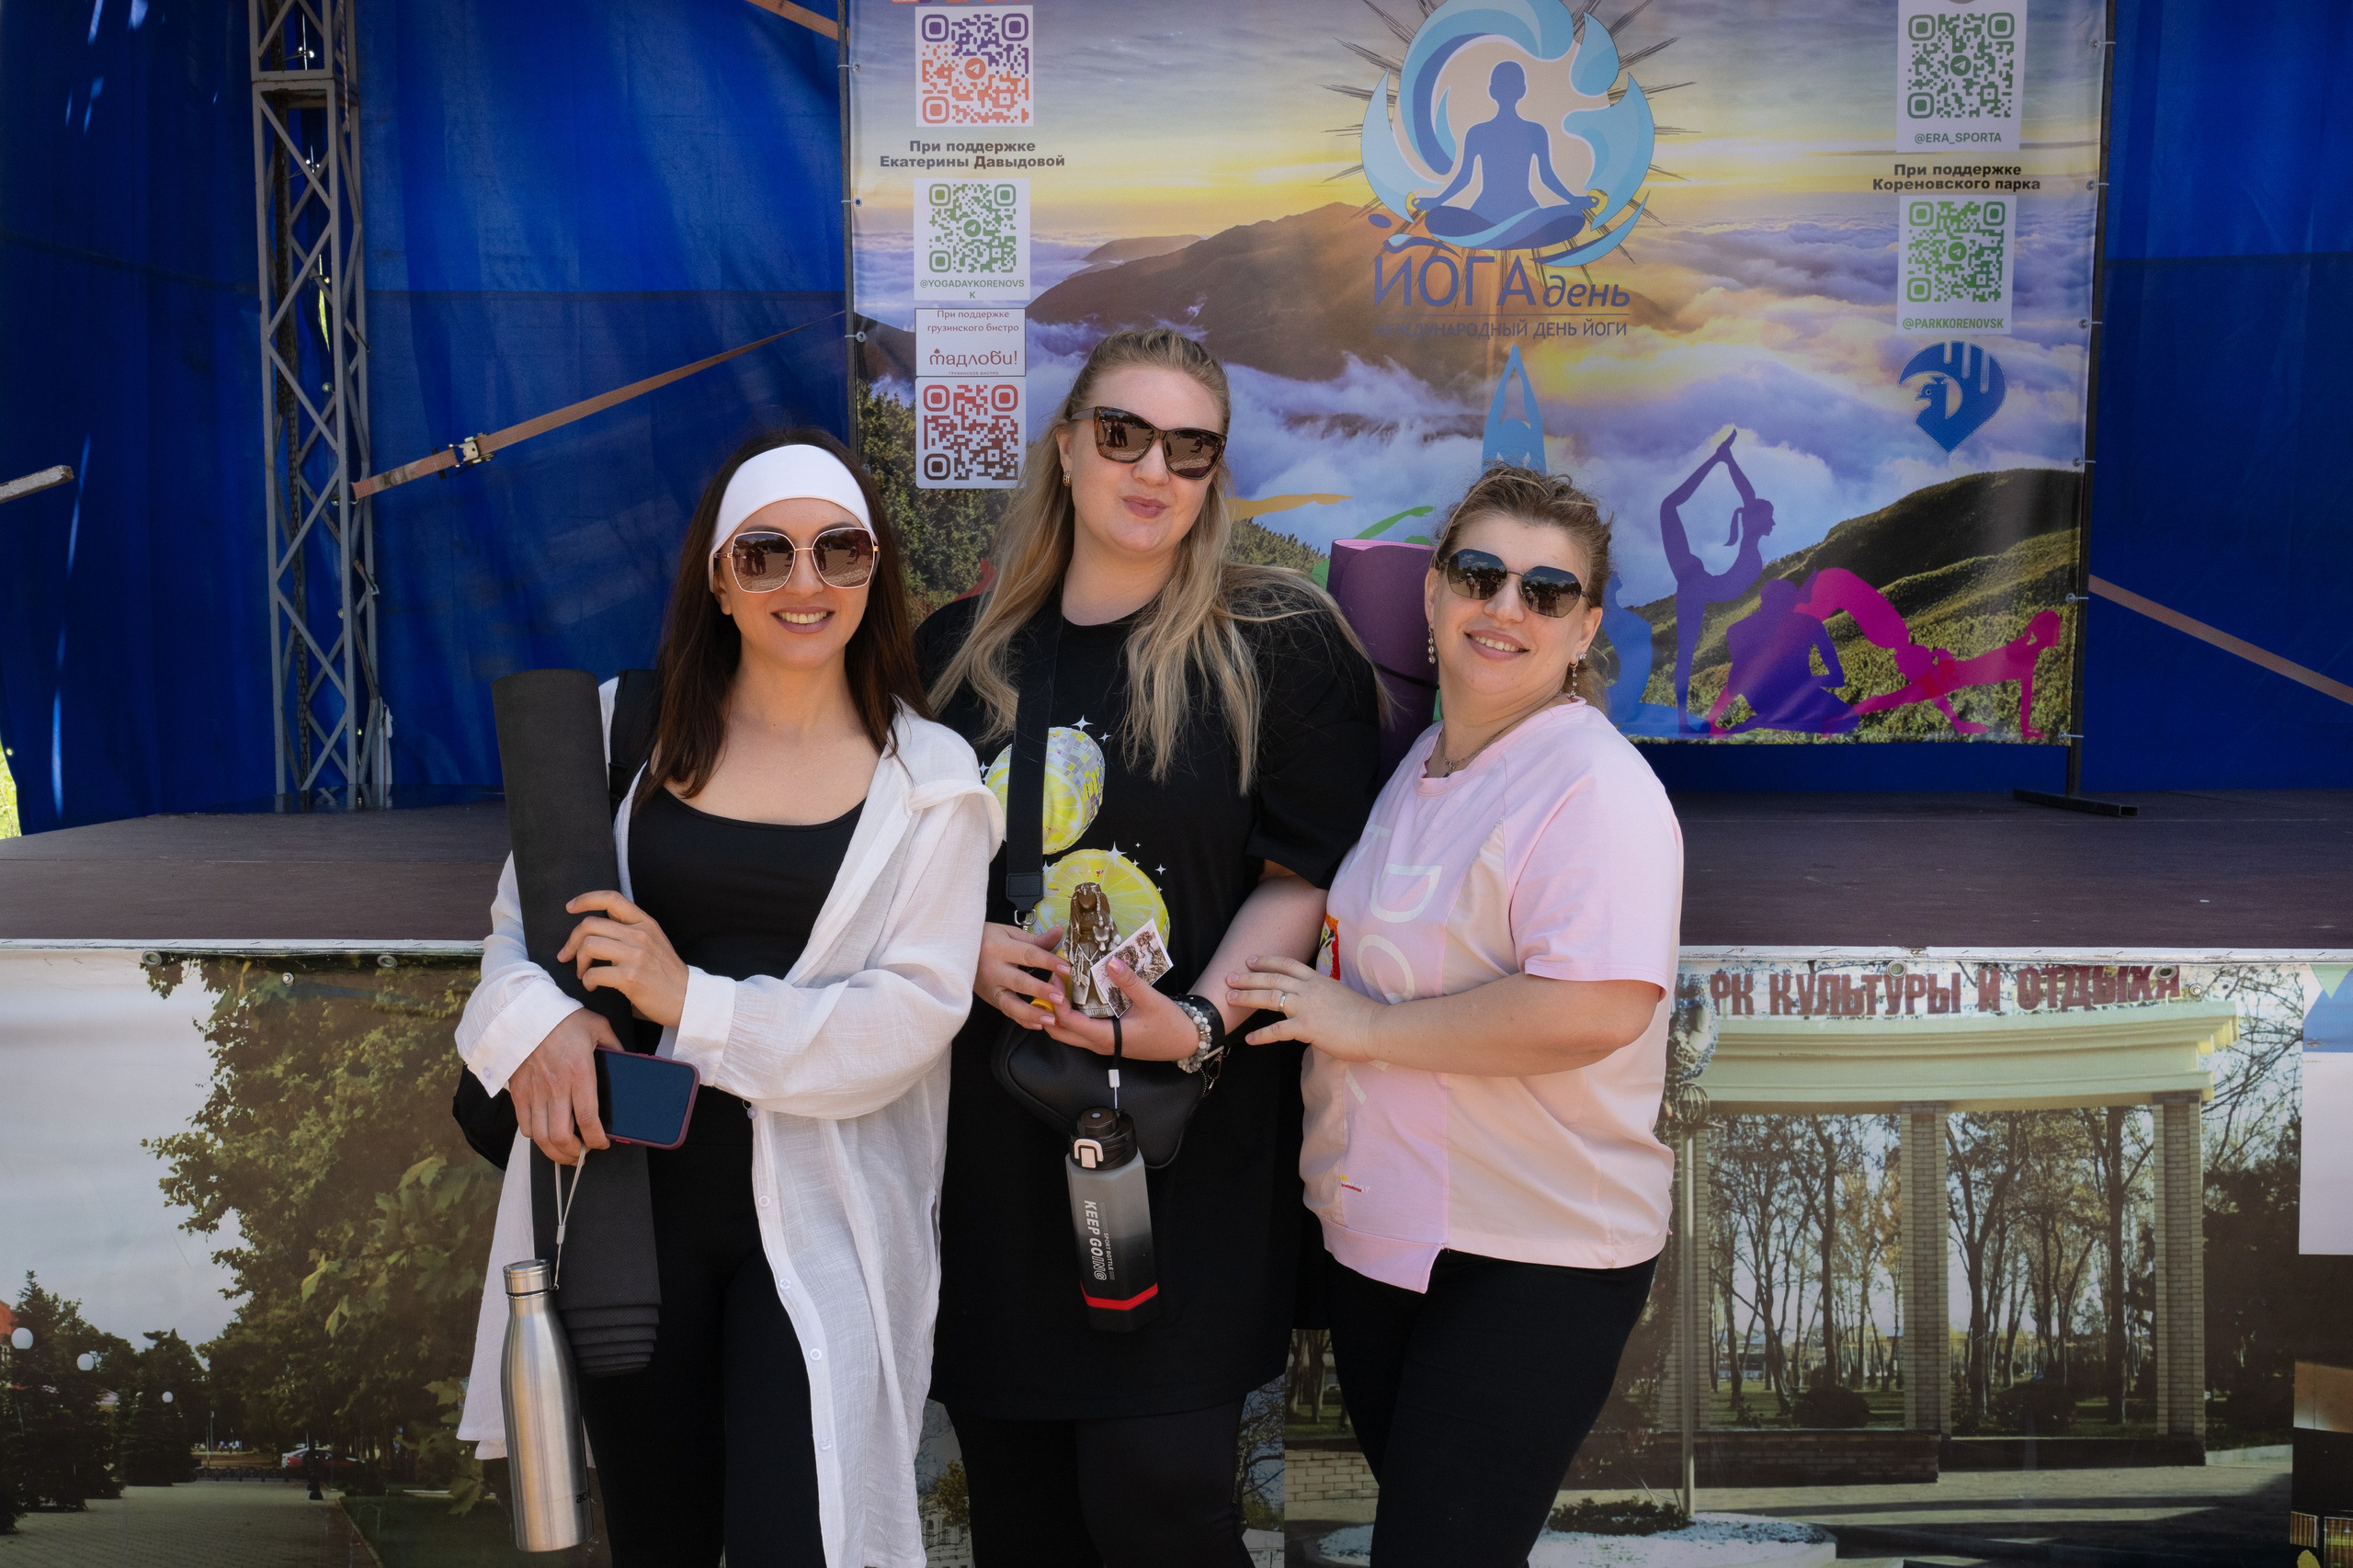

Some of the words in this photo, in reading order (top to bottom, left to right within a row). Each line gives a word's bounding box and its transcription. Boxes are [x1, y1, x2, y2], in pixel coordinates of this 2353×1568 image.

[1914, 131, 2002, 144] @ERA_SPORTA
[909, 140, 941, 155] При
[946, 141, 1036, 155] поддержке
[880, 155, 969, 170] Екатерины
[973, 154, 1065, 170] Давыдовой
[1893, 164, 1927, 178] При
[1932, 165, 2022, 178] поддержке
[1872, 178, 1990, 193] Кореновского
[1995, 180, 2040, 193] парка
[1374, 236, 1537, 307] ЙОГА
[1543, 274, 1631, 308] день
[920, 279, 1025, 289] @YOGADAYKORENOVS
[937, 310, 956, 320] При
[958, 311, 1010, 320] поддержке
[926, 324, 984, 333] грузинского
[986, 323, 1019, 333] бистро
[1373, 318, 1528, 340] МЕЖДУНАРОДНЫЙ
[1533, 322, 1578, 339] ДЕНЬ
[1583, 318, 1628, 336] ЙОГИ
[1902, 317, 2004, 330] @PARKKORENOVSK
[1768, 972, 1961, 1017] КУЛЬТУРЫ
[1977, 968, 2001, 1012] И
[2017, 965, 2181, 1012] ОТДЫХА
[1084, 1199, 1101, 1235] KEEP
[1103, 1232, 1111, 1250] SPORT
[1089, 1237, 1108, 1281] GOING
[1106, 1250, 1114, 1271] BOTTLE
